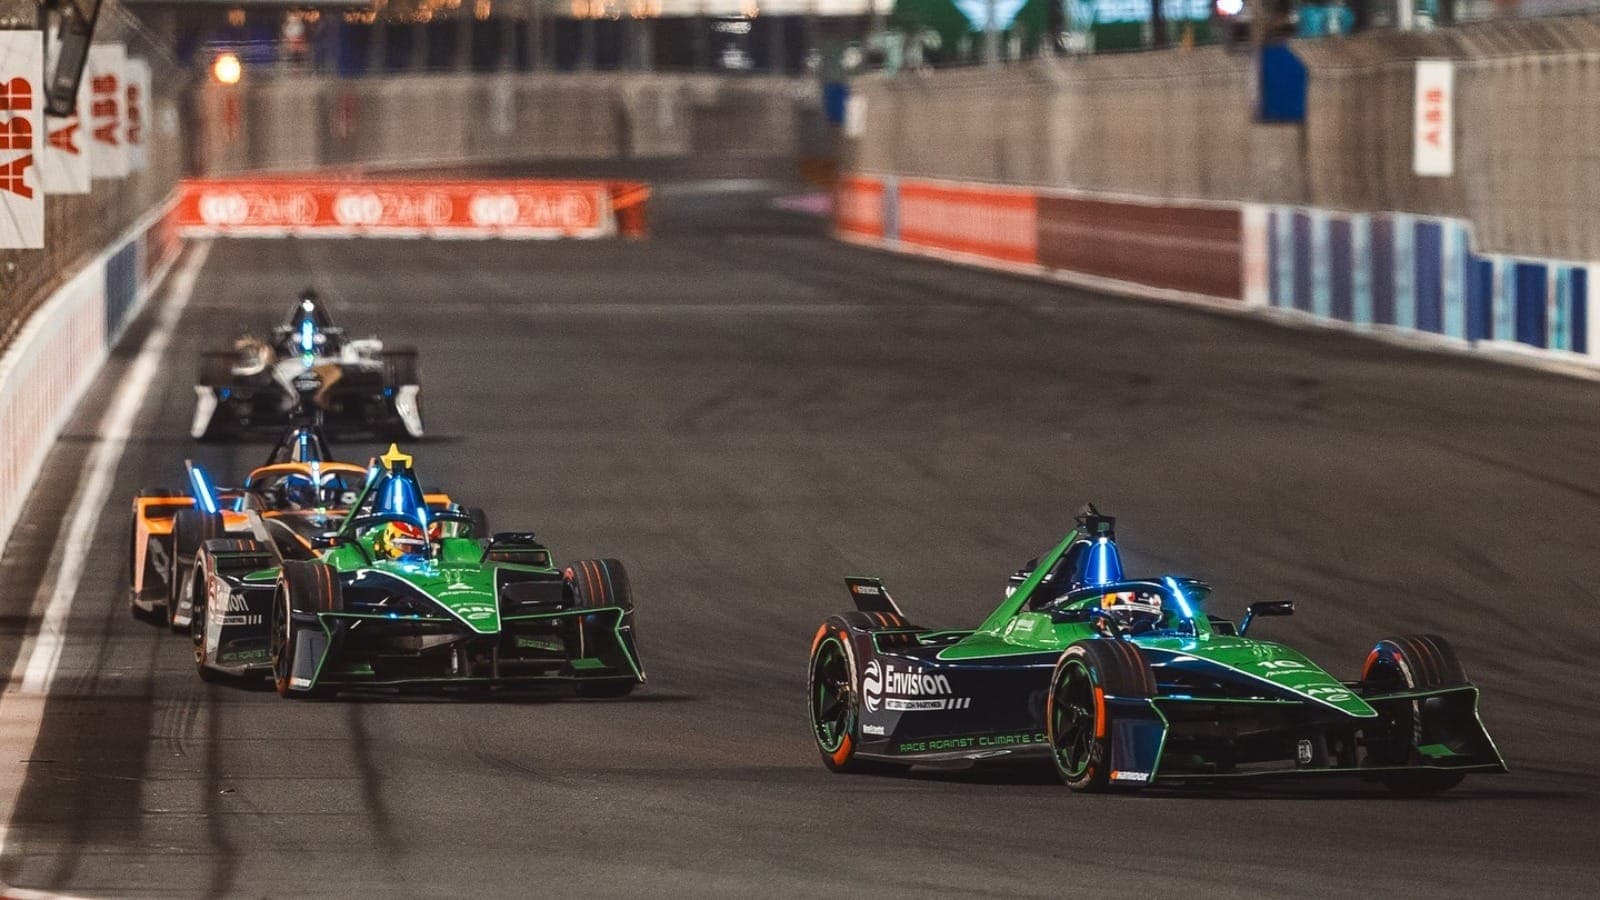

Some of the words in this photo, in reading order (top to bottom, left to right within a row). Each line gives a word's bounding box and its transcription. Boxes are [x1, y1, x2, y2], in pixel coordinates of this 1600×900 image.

[91, 74, 119, 146] ABB
[0, 77, 33, 200] ABB
[885, 665, 952, 696] Envision
[900, 742, 926, 753] RACE
[929, 738, 976, 750] AGAINST
[979, 734, 1031, 746] CLIMATE
